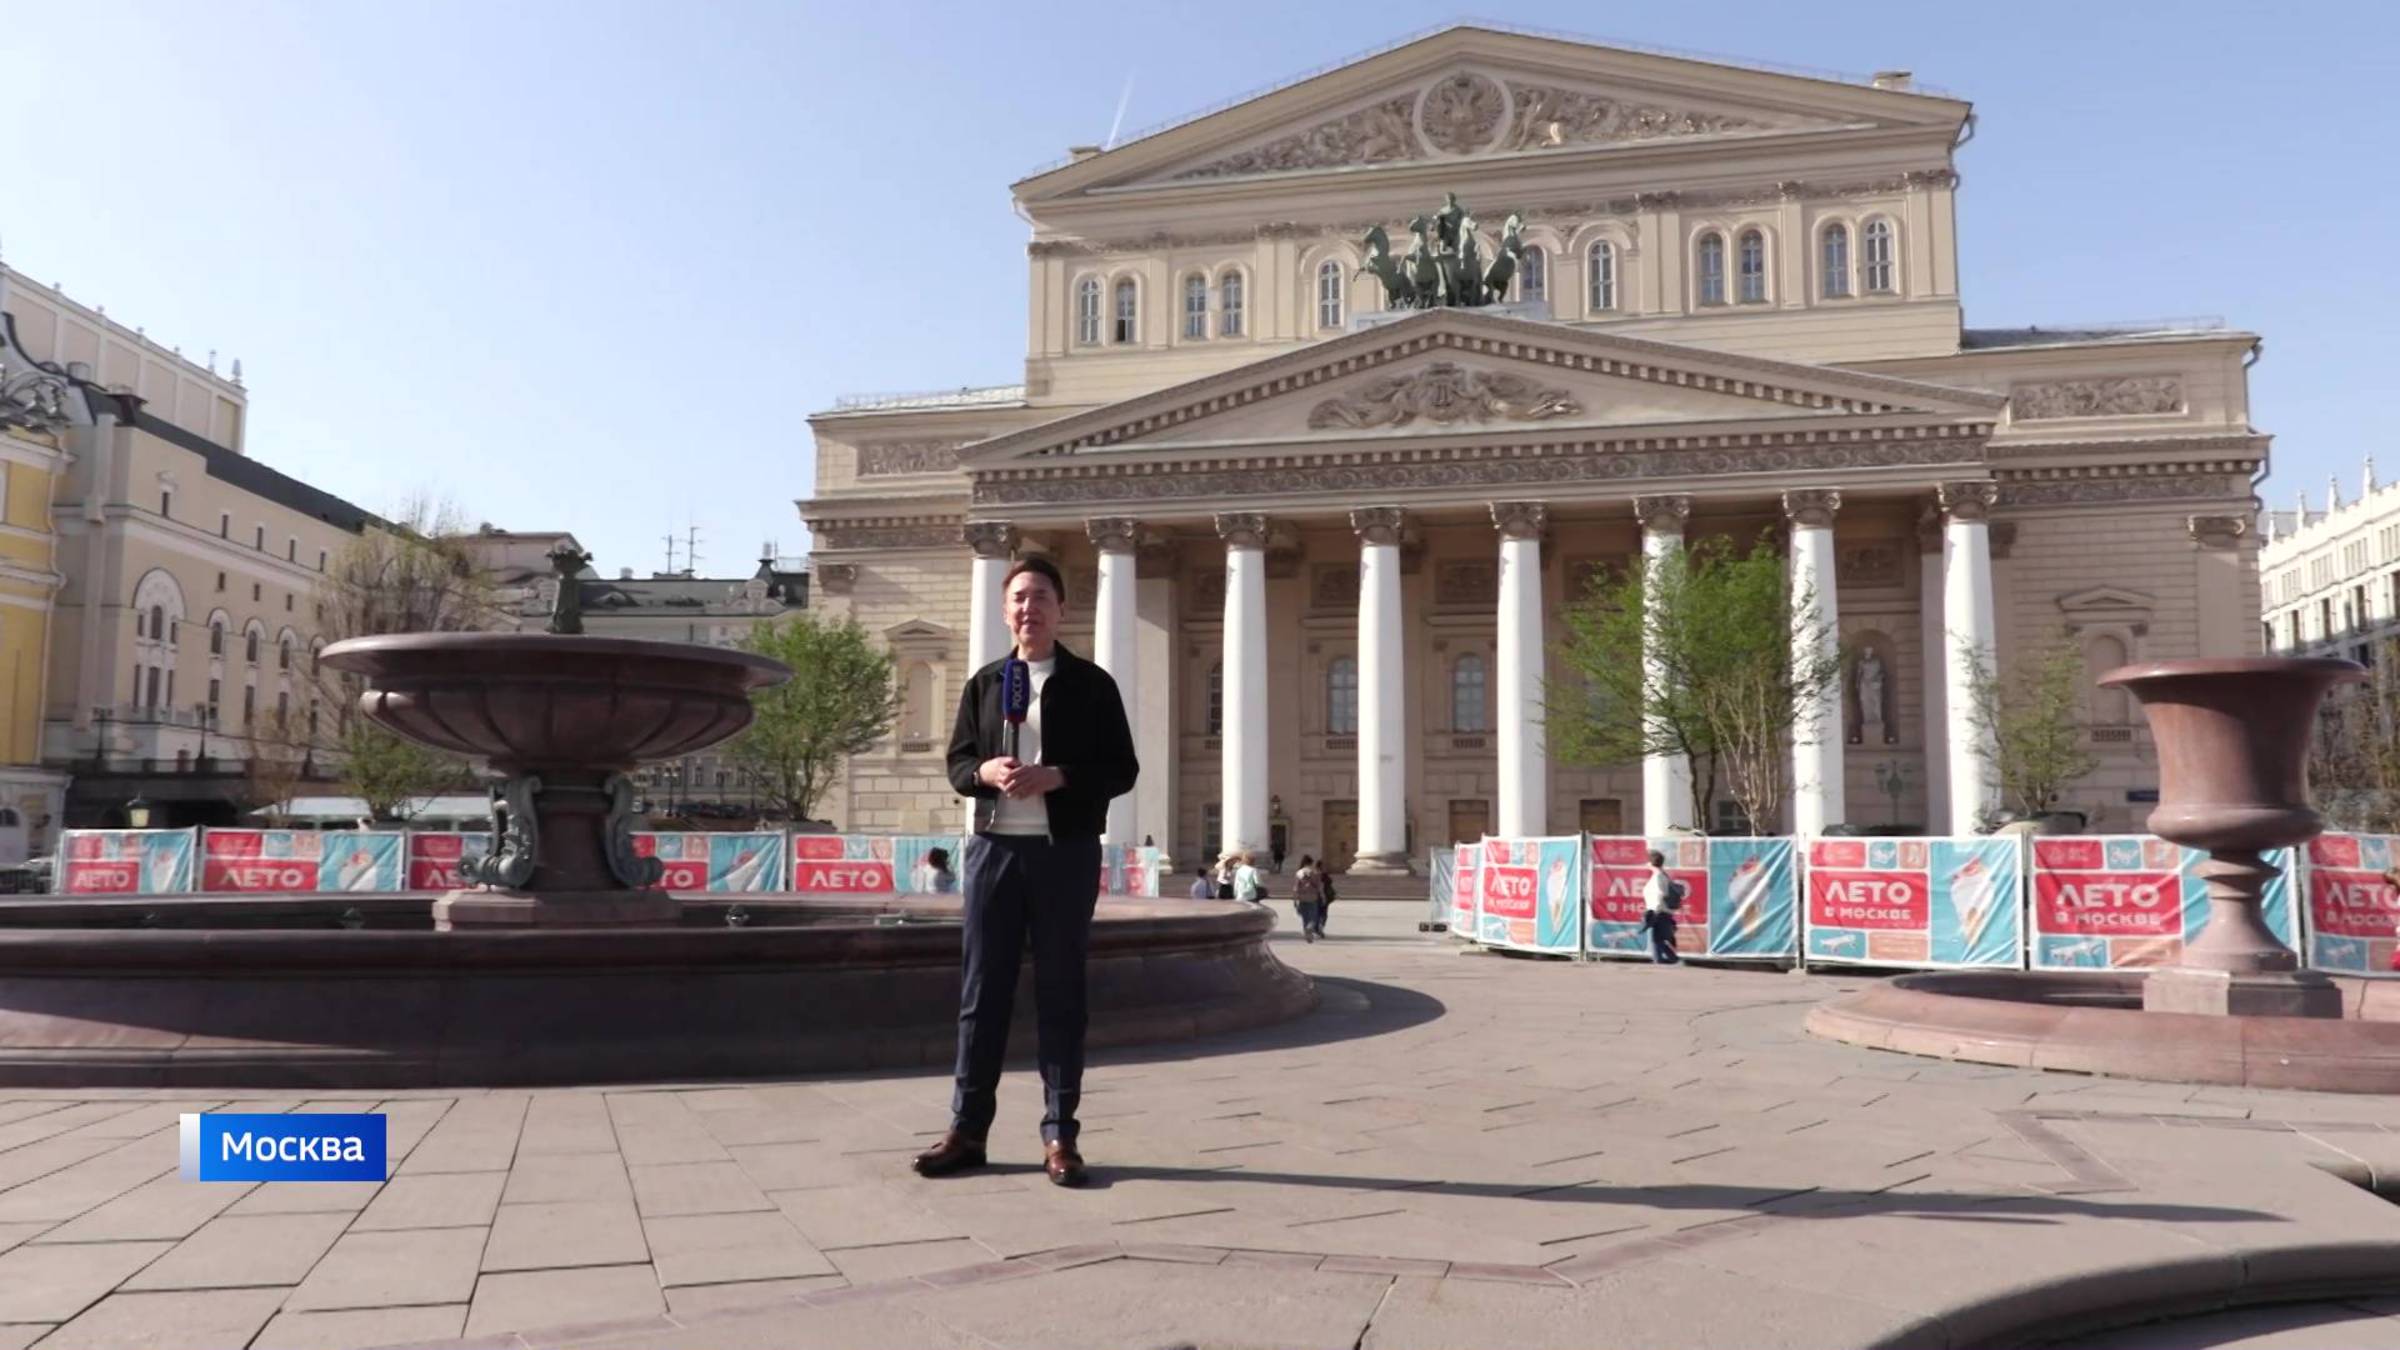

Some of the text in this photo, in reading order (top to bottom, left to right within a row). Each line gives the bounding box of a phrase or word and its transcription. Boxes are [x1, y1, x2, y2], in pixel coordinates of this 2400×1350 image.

[74, 870, 130, 888] ЛЕТО
[221, 868, 304, 888] ЛЕТО
[424, 868, 463, 888] ЛЕ
[660, 868, 695, 889] ТО
[809, 868, 881, 890] ЛЕТО
[1490, 876, 1531, 897] ЛЕТО
[1825, 880, 1912, 905] ЛЕТО
[2056, 882, 2161, 909] ЛЕТО
[2326, 882, 2400, 909] ЛЕТО
[1839, 907, 1912, 921] МОСКВЕ
[2055, 910, 2162, 927] В МОСКВЕ
